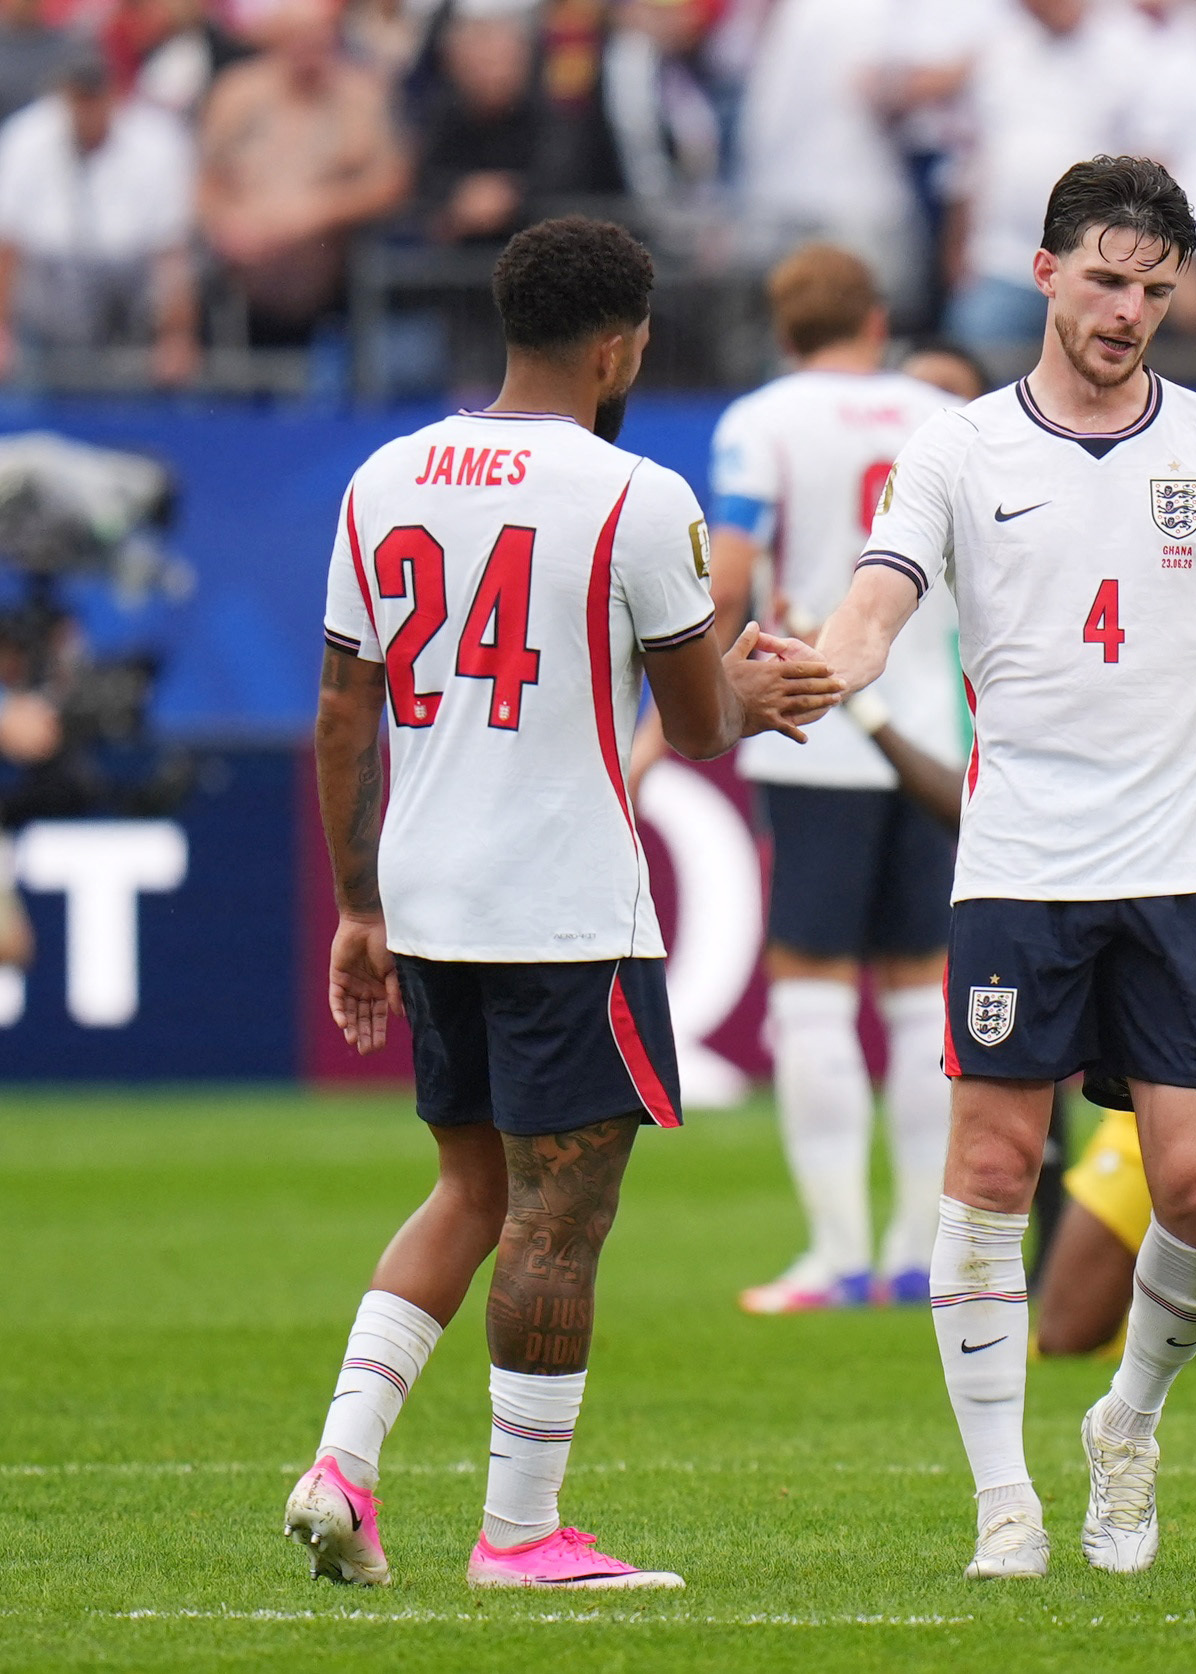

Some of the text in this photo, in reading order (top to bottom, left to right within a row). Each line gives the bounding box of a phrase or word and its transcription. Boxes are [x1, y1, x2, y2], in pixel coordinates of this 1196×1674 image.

[415, 446, 532, 486] JAMES
[1161, 558, 1193, 569] 23.06.26
[1162, 545, 1193, 556] GHANA
[374, 524, 541, 732] 24
[1083, 579, 1125, 663] 4
